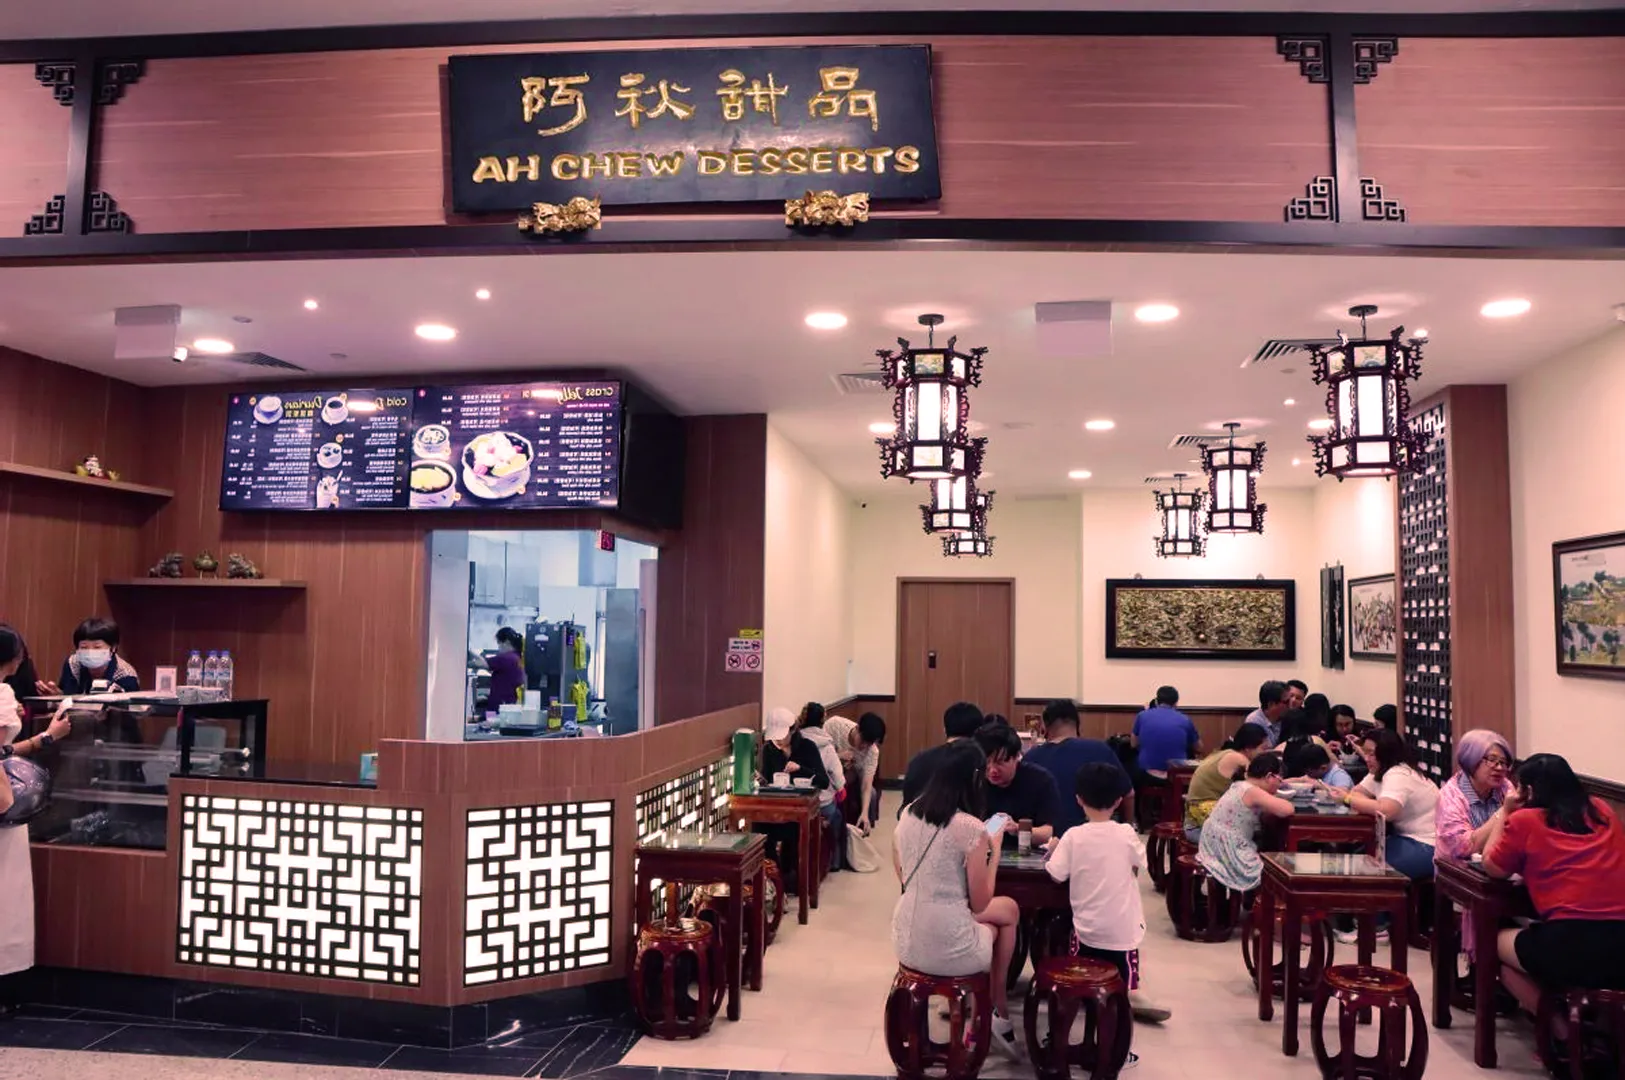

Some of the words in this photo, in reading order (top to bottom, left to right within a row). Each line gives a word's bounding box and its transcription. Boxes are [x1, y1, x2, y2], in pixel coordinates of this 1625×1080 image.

[521, 67, 879, 136] 阿秋甜品
[472, 154, 541, 183] AH
[551, 151, 684, 180] CHEW
[697, 145, 920, 175] DESSERTS
